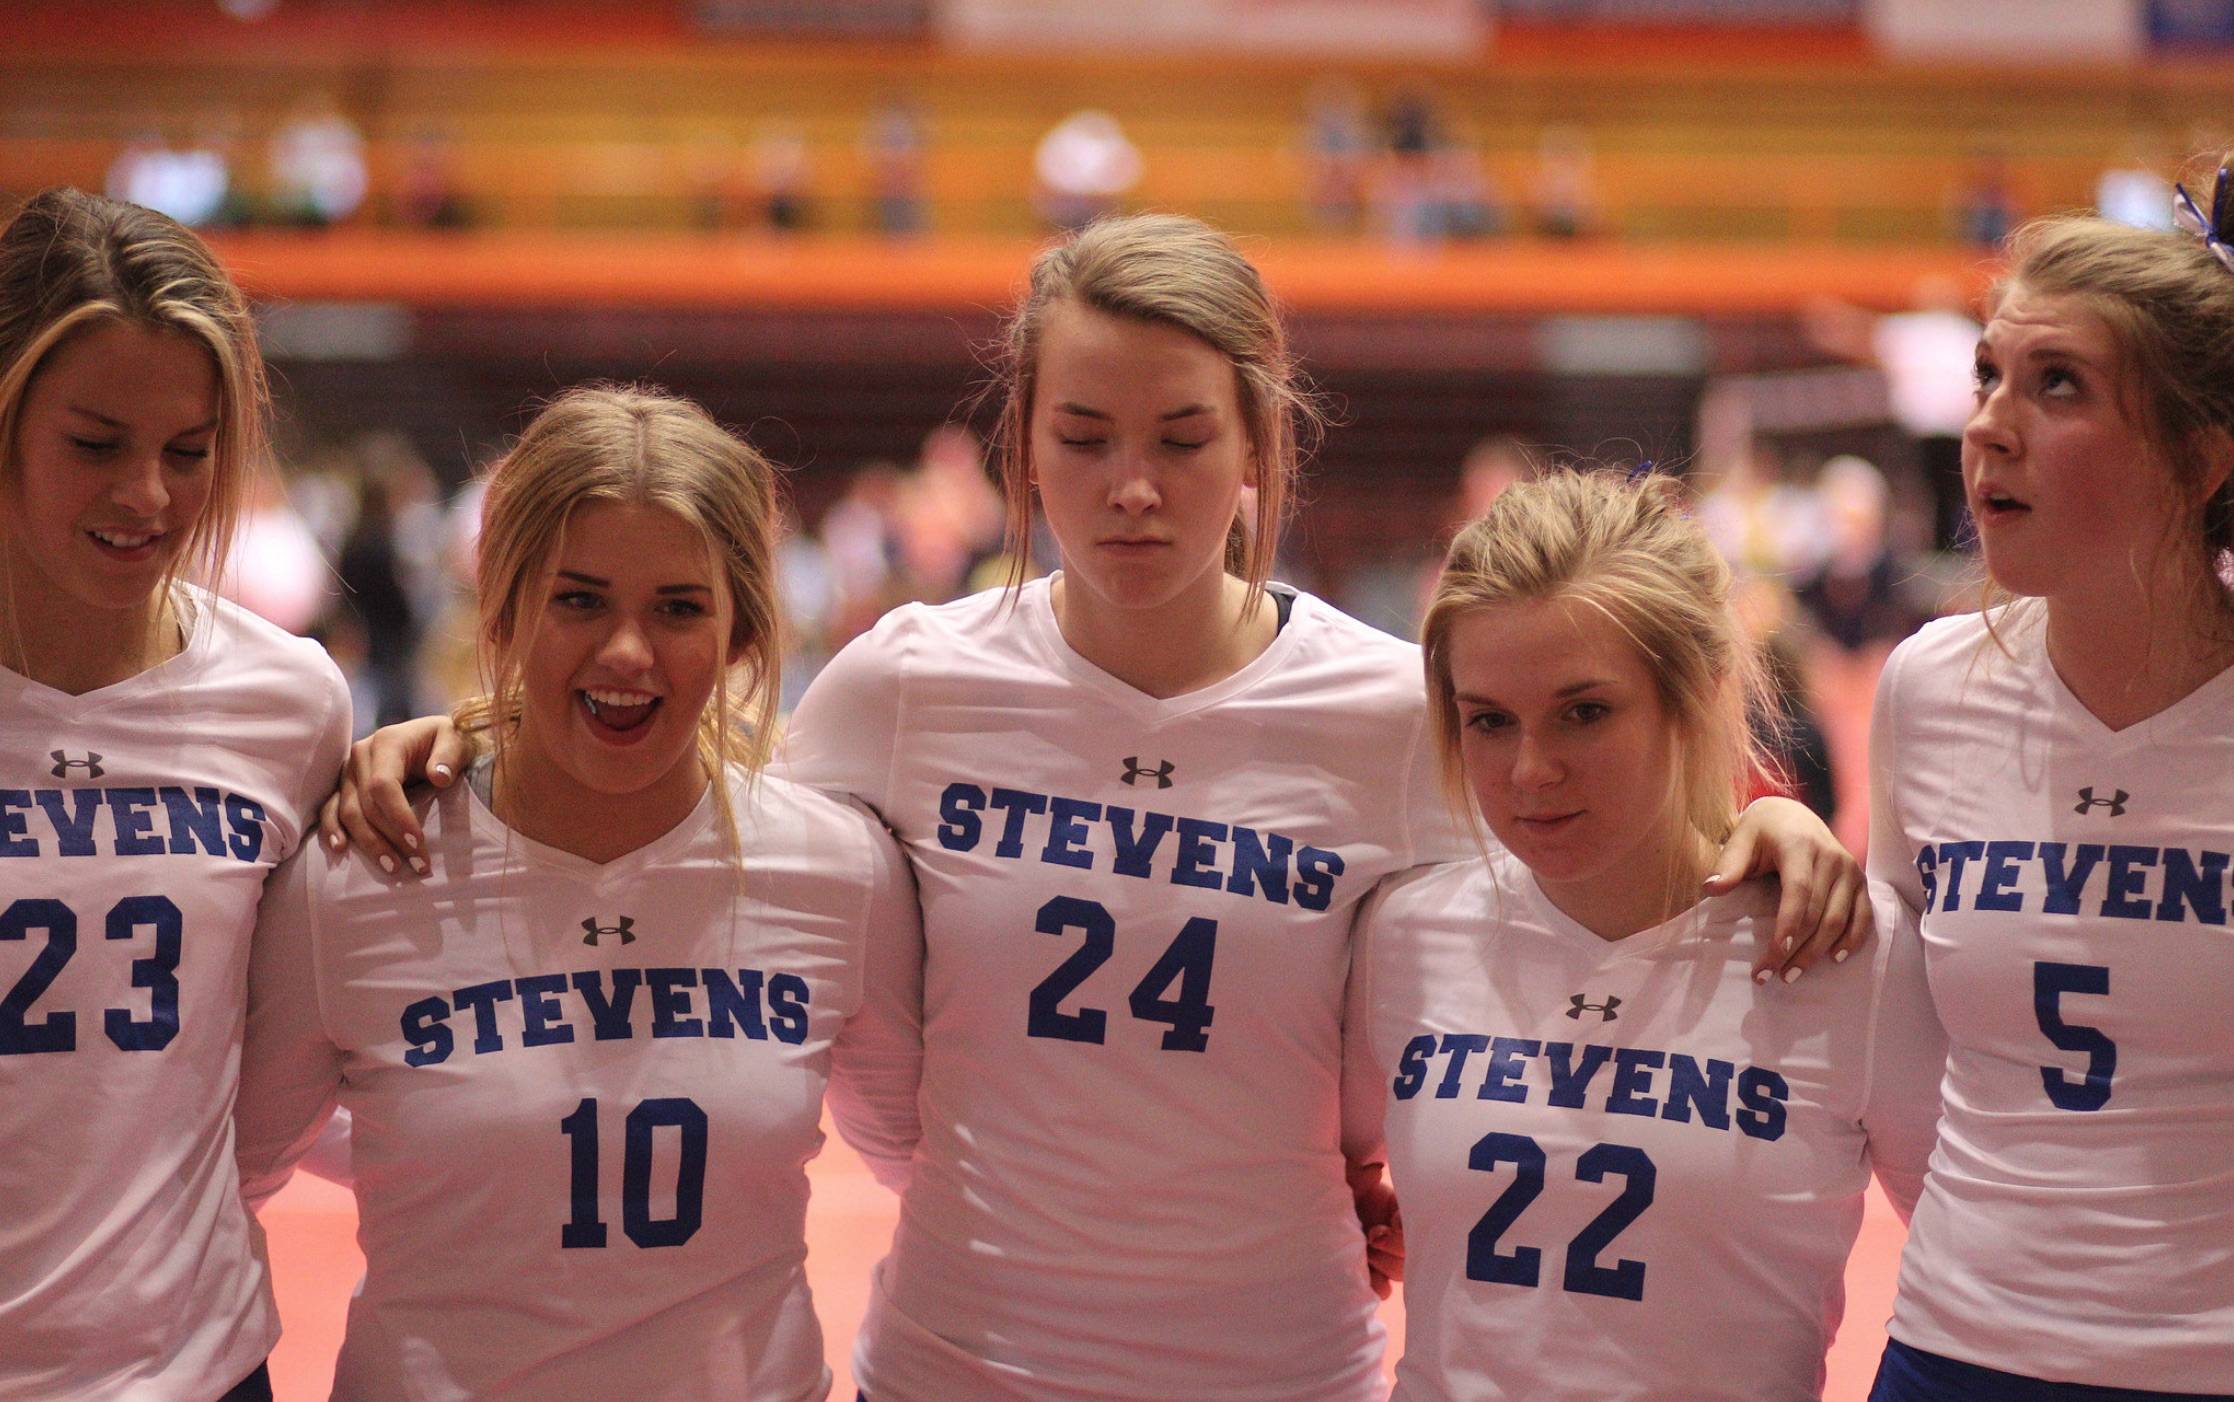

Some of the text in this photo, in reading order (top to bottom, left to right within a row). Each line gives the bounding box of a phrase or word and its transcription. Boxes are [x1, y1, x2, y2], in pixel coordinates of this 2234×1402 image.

[0, 786, 266, 863] EVENS
[937, 782, 1345, 912] STEVENS
[1916, 840, 2234, 925] STEVEN
[0, 895, 183, 1055] 23
[400, 967, 810, 1068] STEVENS
[1027, 894, 1219, 1053] 24
[2033, 960, 2117, 1112] 5
[1392, 1033, 1790, 1142] STEVENS
[560, 1097, 709, 1249] 10
[1465, 1131, 1657, 1302] 22
